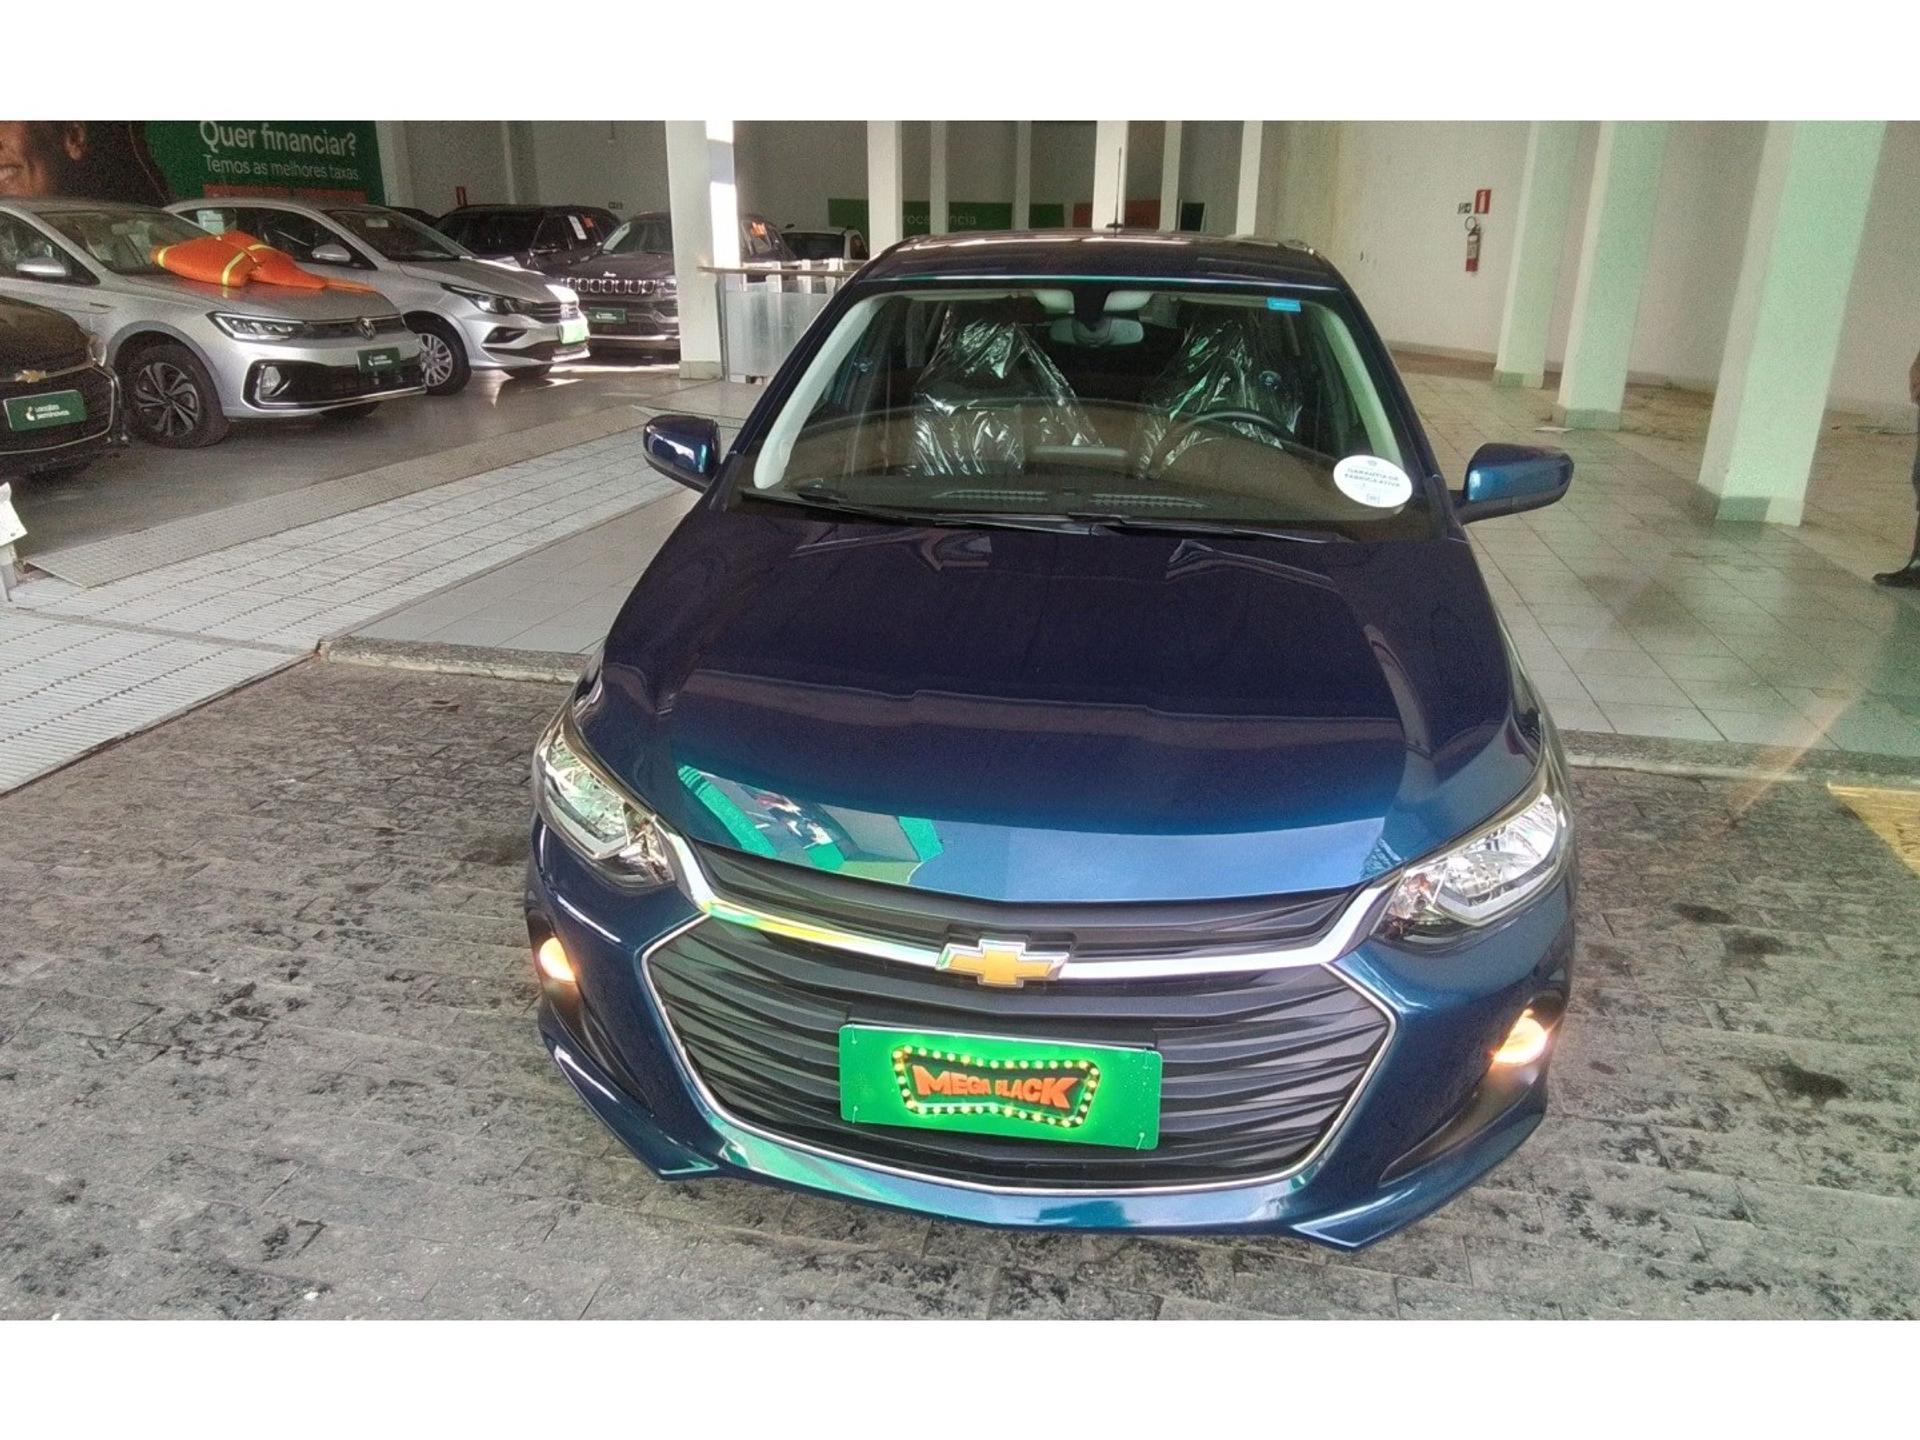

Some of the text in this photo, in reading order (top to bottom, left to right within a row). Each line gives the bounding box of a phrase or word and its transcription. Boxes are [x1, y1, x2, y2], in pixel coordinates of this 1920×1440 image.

[200, 121, 357, 157] Quer financiar?
[203, 154, 250, 174] Temos
[253, 160, 268, 175] as
[271, 160, 327, 178] melhores
[911, 1064, 992, 1096] MEGA
